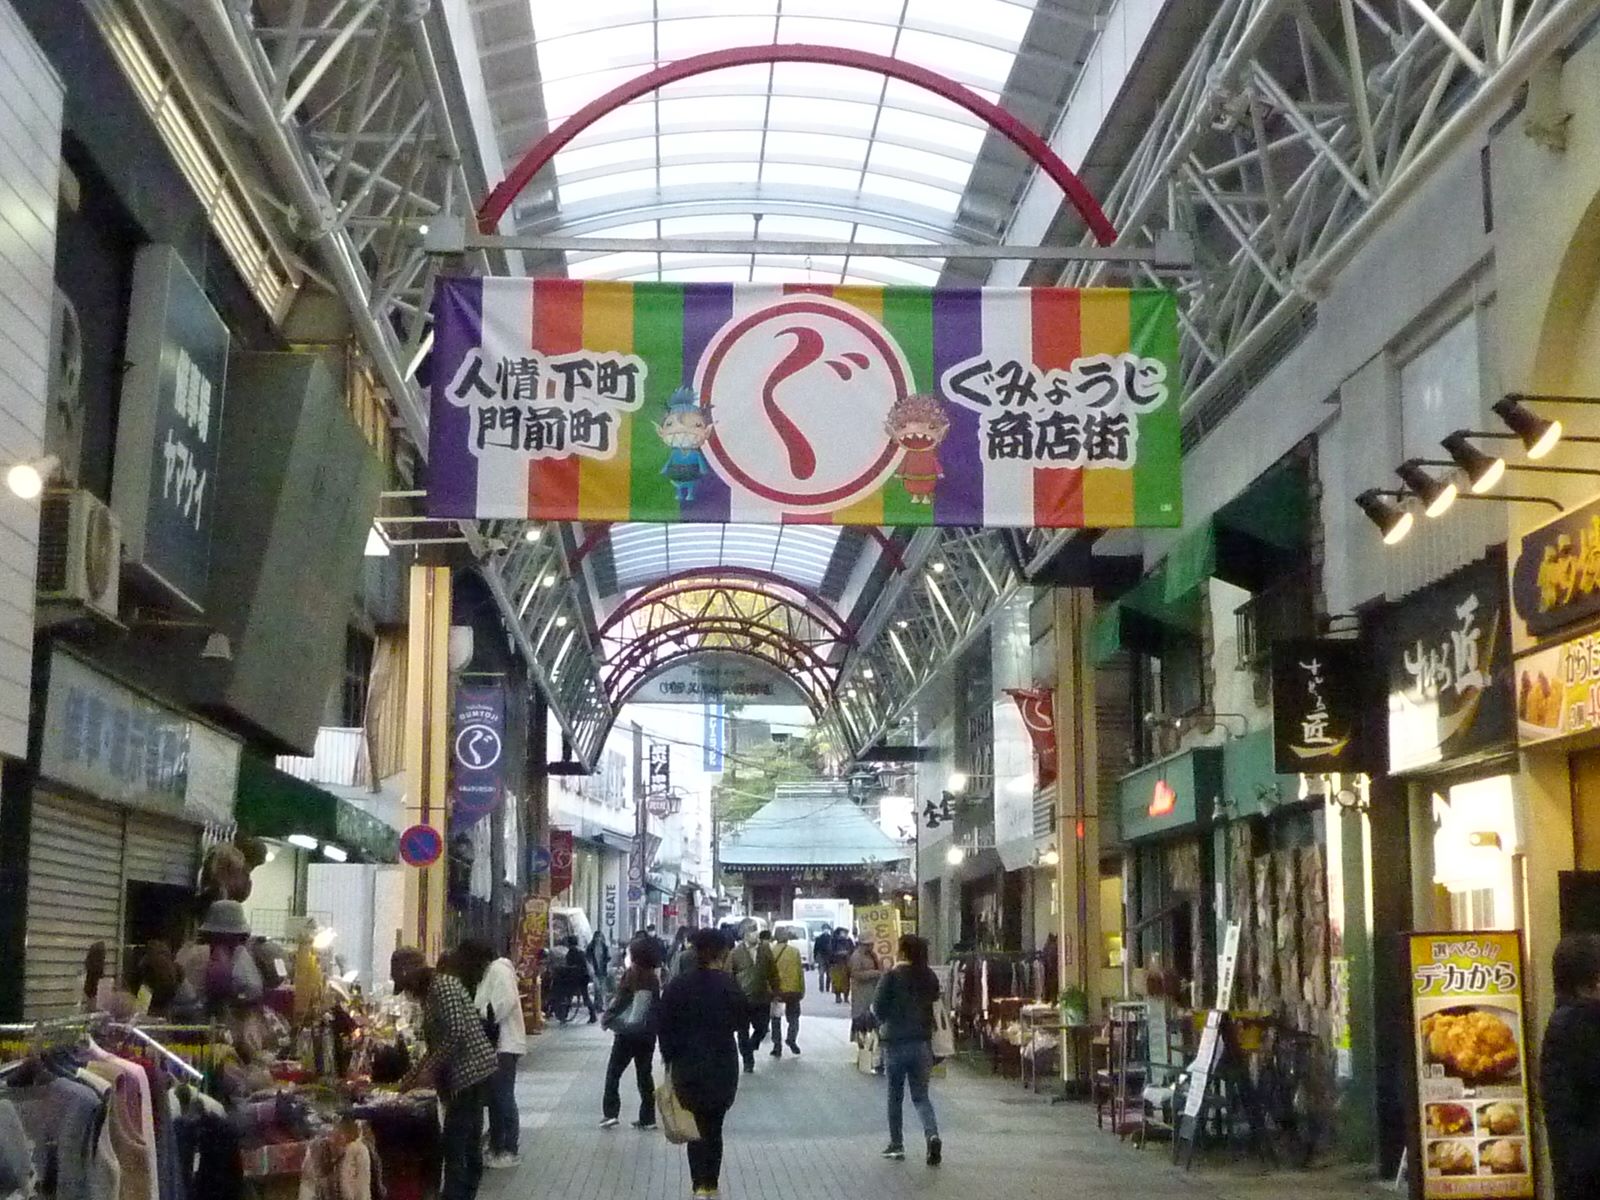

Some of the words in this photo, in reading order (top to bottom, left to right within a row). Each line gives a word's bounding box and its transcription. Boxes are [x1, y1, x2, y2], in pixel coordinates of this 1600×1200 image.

[949, 359, 1160, 408] ぐみょうじ
[477, 406, 613, 452] 門前町
[987, 409, 1131, 461] 商店街
[163, 428, 207, 531] ヤマケイ
[605, 884, 617, 927] CREATE
[1415, 962, 1517, 993] デカから
